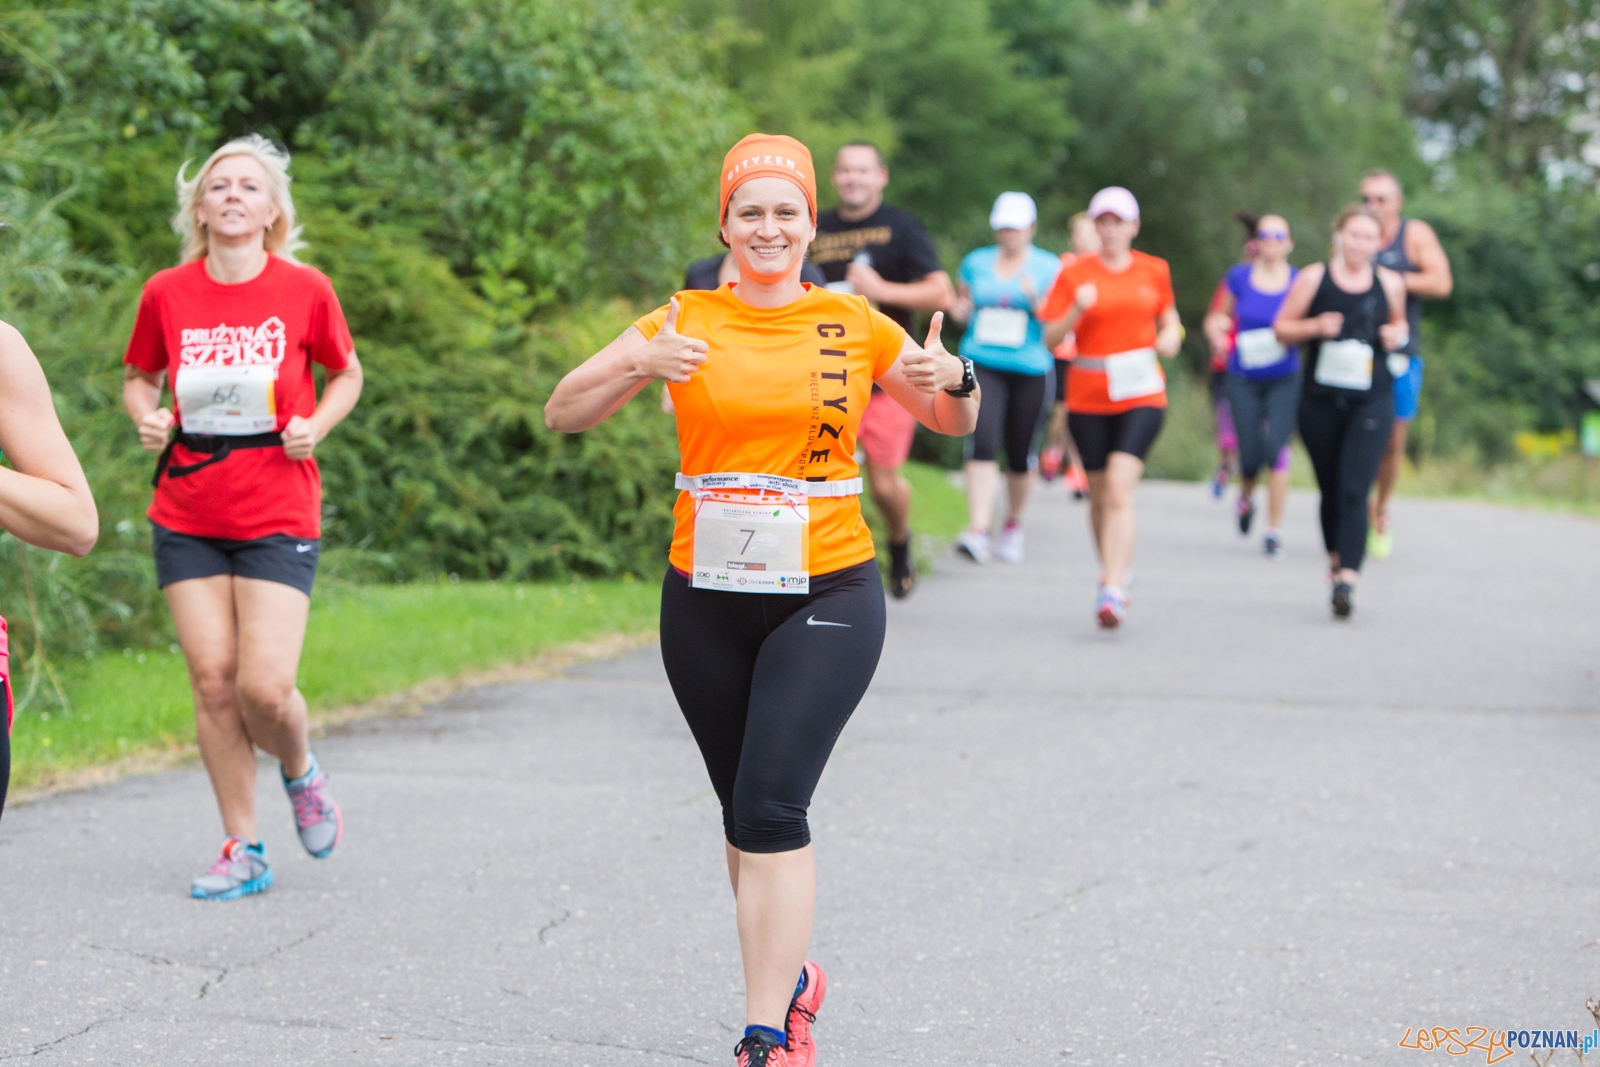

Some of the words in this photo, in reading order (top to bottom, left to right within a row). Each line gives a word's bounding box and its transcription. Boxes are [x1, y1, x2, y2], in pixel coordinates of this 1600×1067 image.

[727, 155, 795, 181] CITYZEN
[180, 322, 267, 346] DRUŻYNA
[180, 340, 287, 367] SZPIKU
[211, 383, 241, 405] 66
[739, 529, 756, 556] 7
